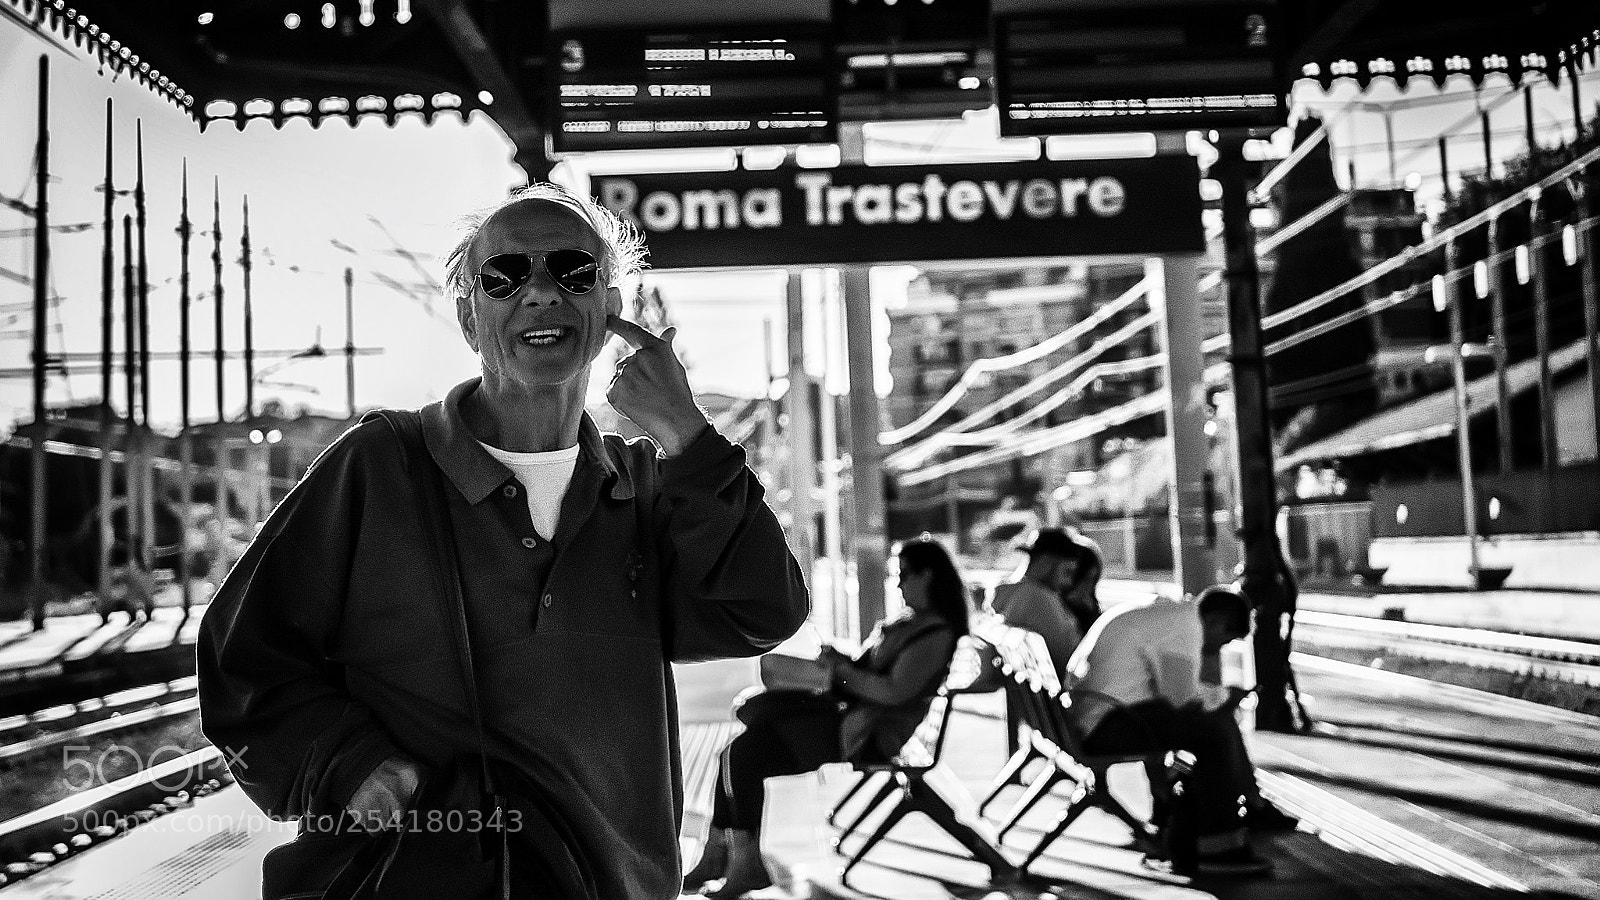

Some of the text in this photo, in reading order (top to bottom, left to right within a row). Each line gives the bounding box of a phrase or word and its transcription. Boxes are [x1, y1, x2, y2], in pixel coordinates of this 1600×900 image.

[560, 39, 584, 72] 3
[600, 171, 1126, 232] Roma Trastevere
